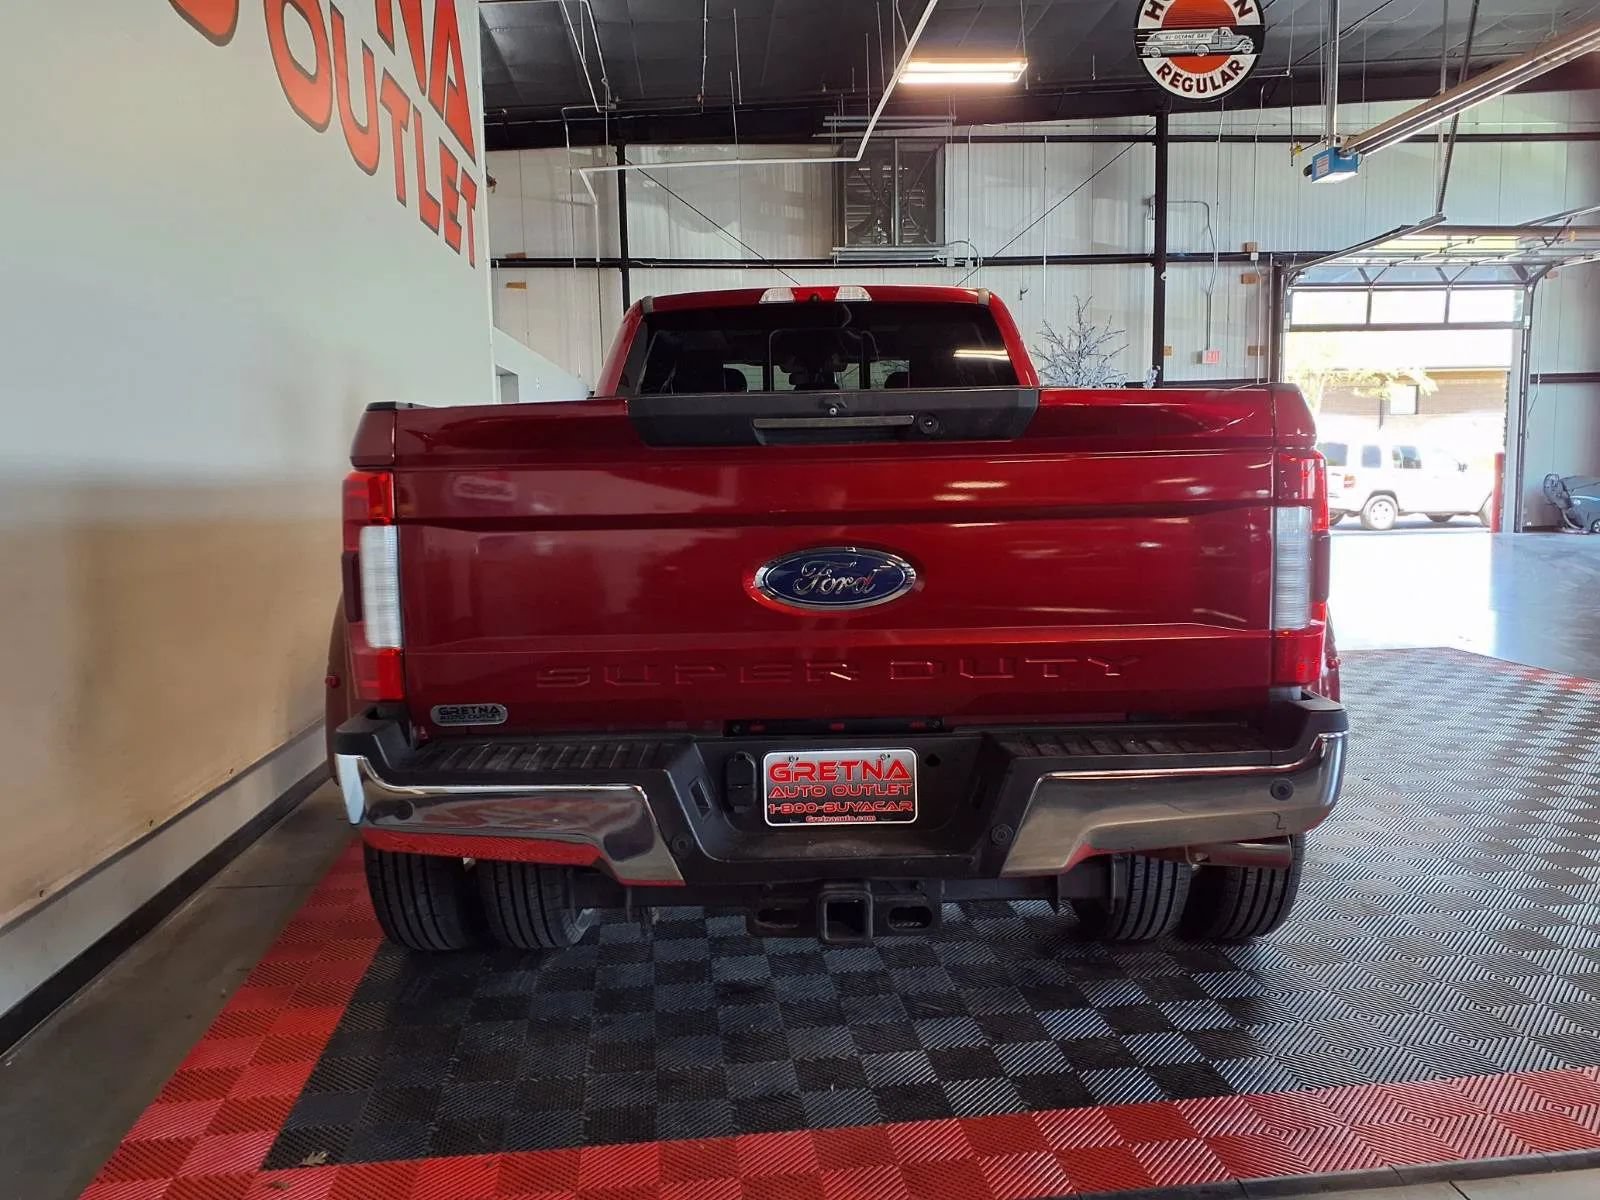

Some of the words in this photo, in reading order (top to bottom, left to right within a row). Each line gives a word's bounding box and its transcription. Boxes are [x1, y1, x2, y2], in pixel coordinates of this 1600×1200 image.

[1156, 59, 1245, 94] REGULAR
[264, 0, 477, 269] OUTLET
[793, 560, 882, 595] Ford
[536, 660, 853, 688] SUPER
[889, 657, 1141, 681] DUTY
[438, 706, 501, 714] GRETNA
[769, 759, 912, 782] GRETNA
[768, 785, 827, 798] AUTO
[832, 783, 912, 796] OUTLET
[769, 801, 913, 814] 1-800-BUYACAR
